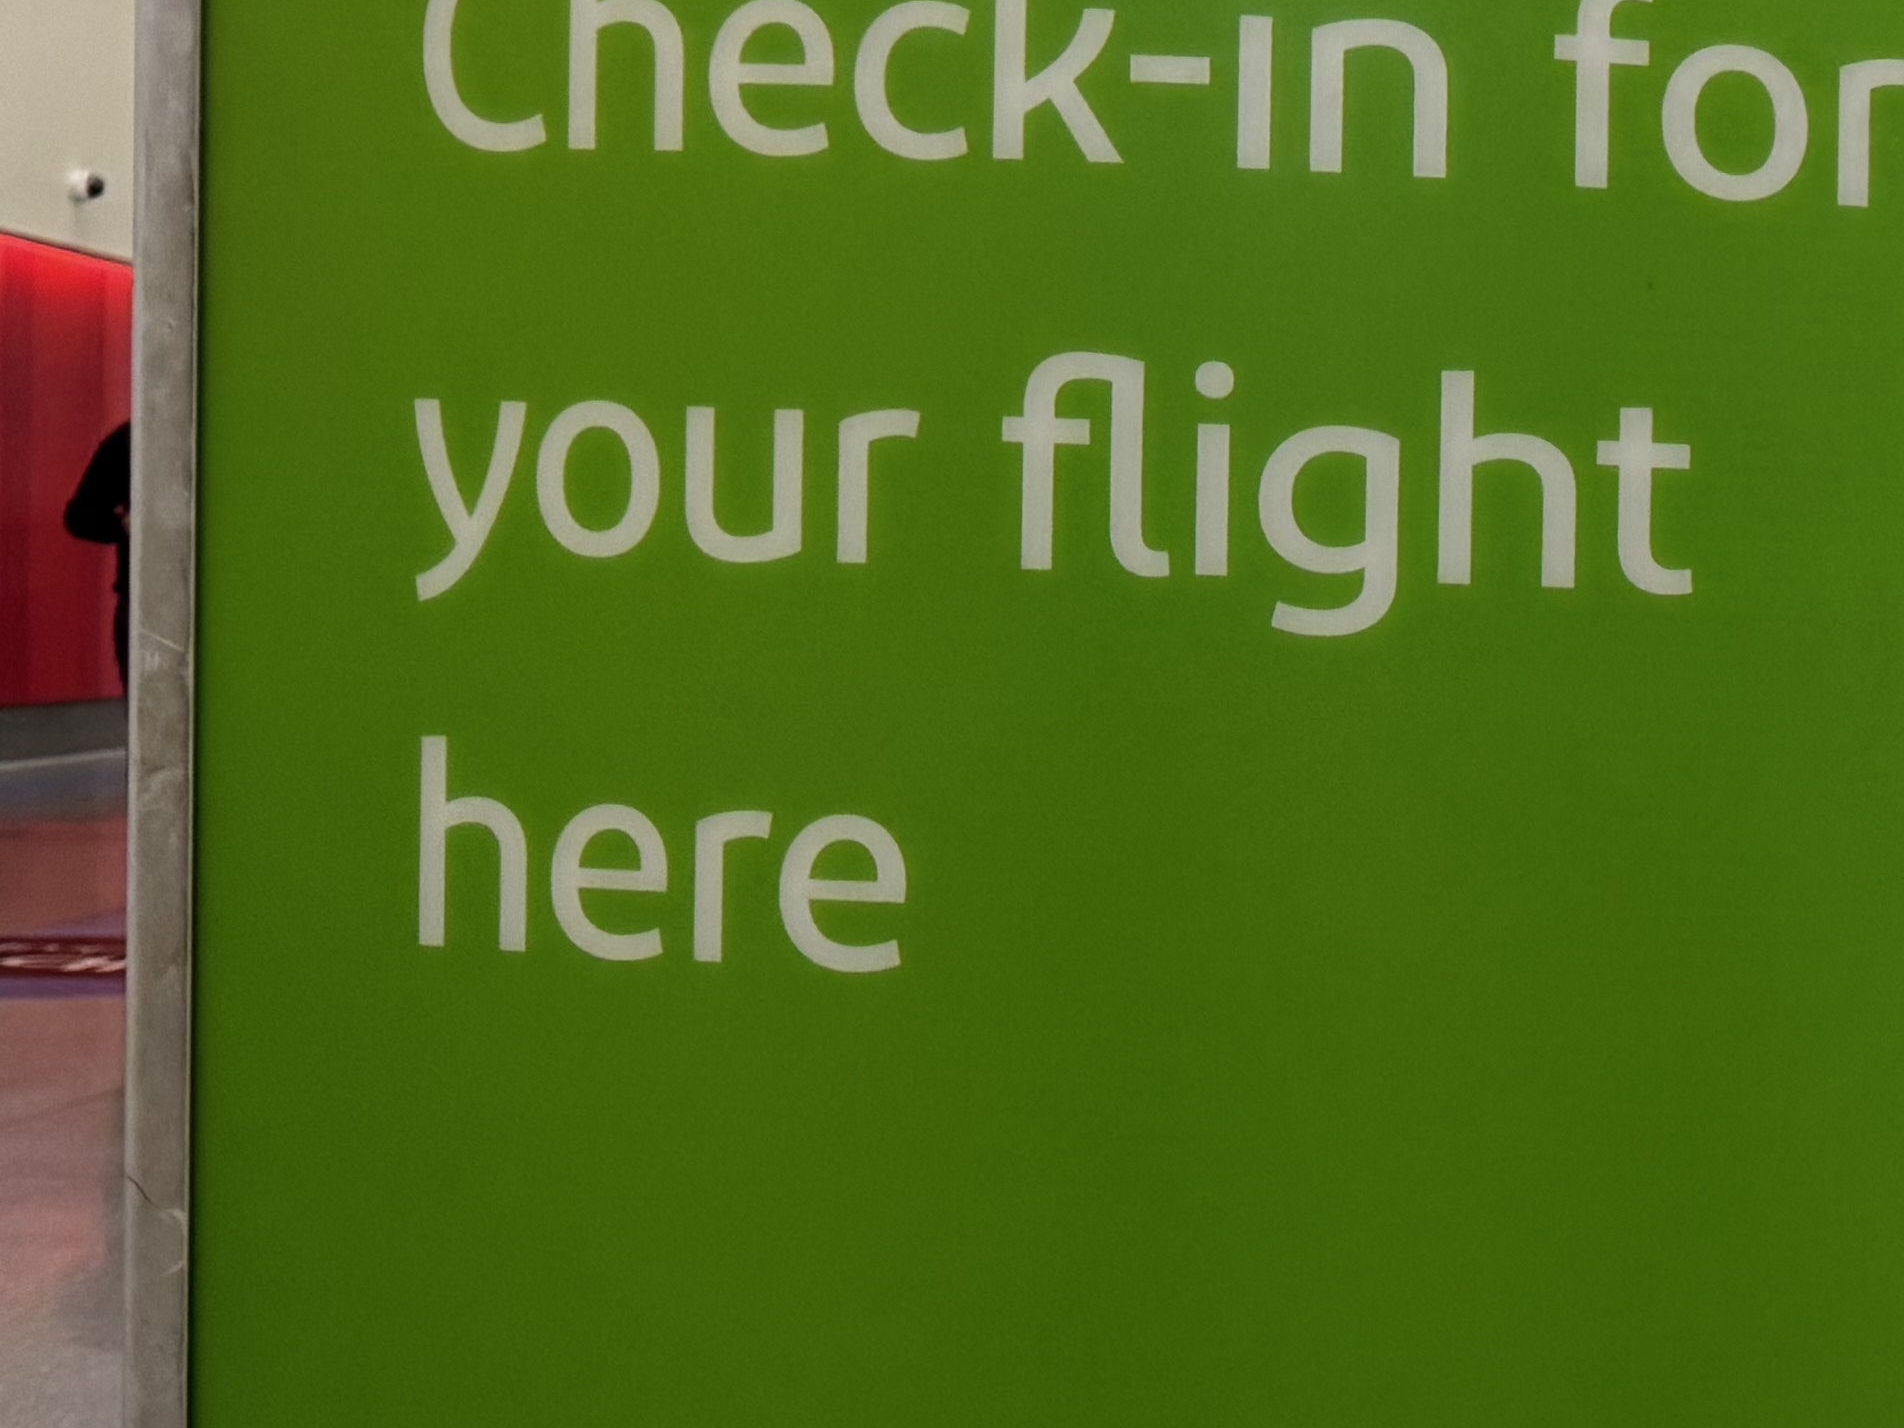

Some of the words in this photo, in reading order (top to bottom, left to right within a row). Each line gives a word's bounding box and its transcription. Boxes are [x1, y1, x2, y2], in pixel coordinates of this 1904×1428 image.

[414, 398, 921, 603] your
[1001, 350, 1695, 639] flight
[417, 733, 909, 974] here
